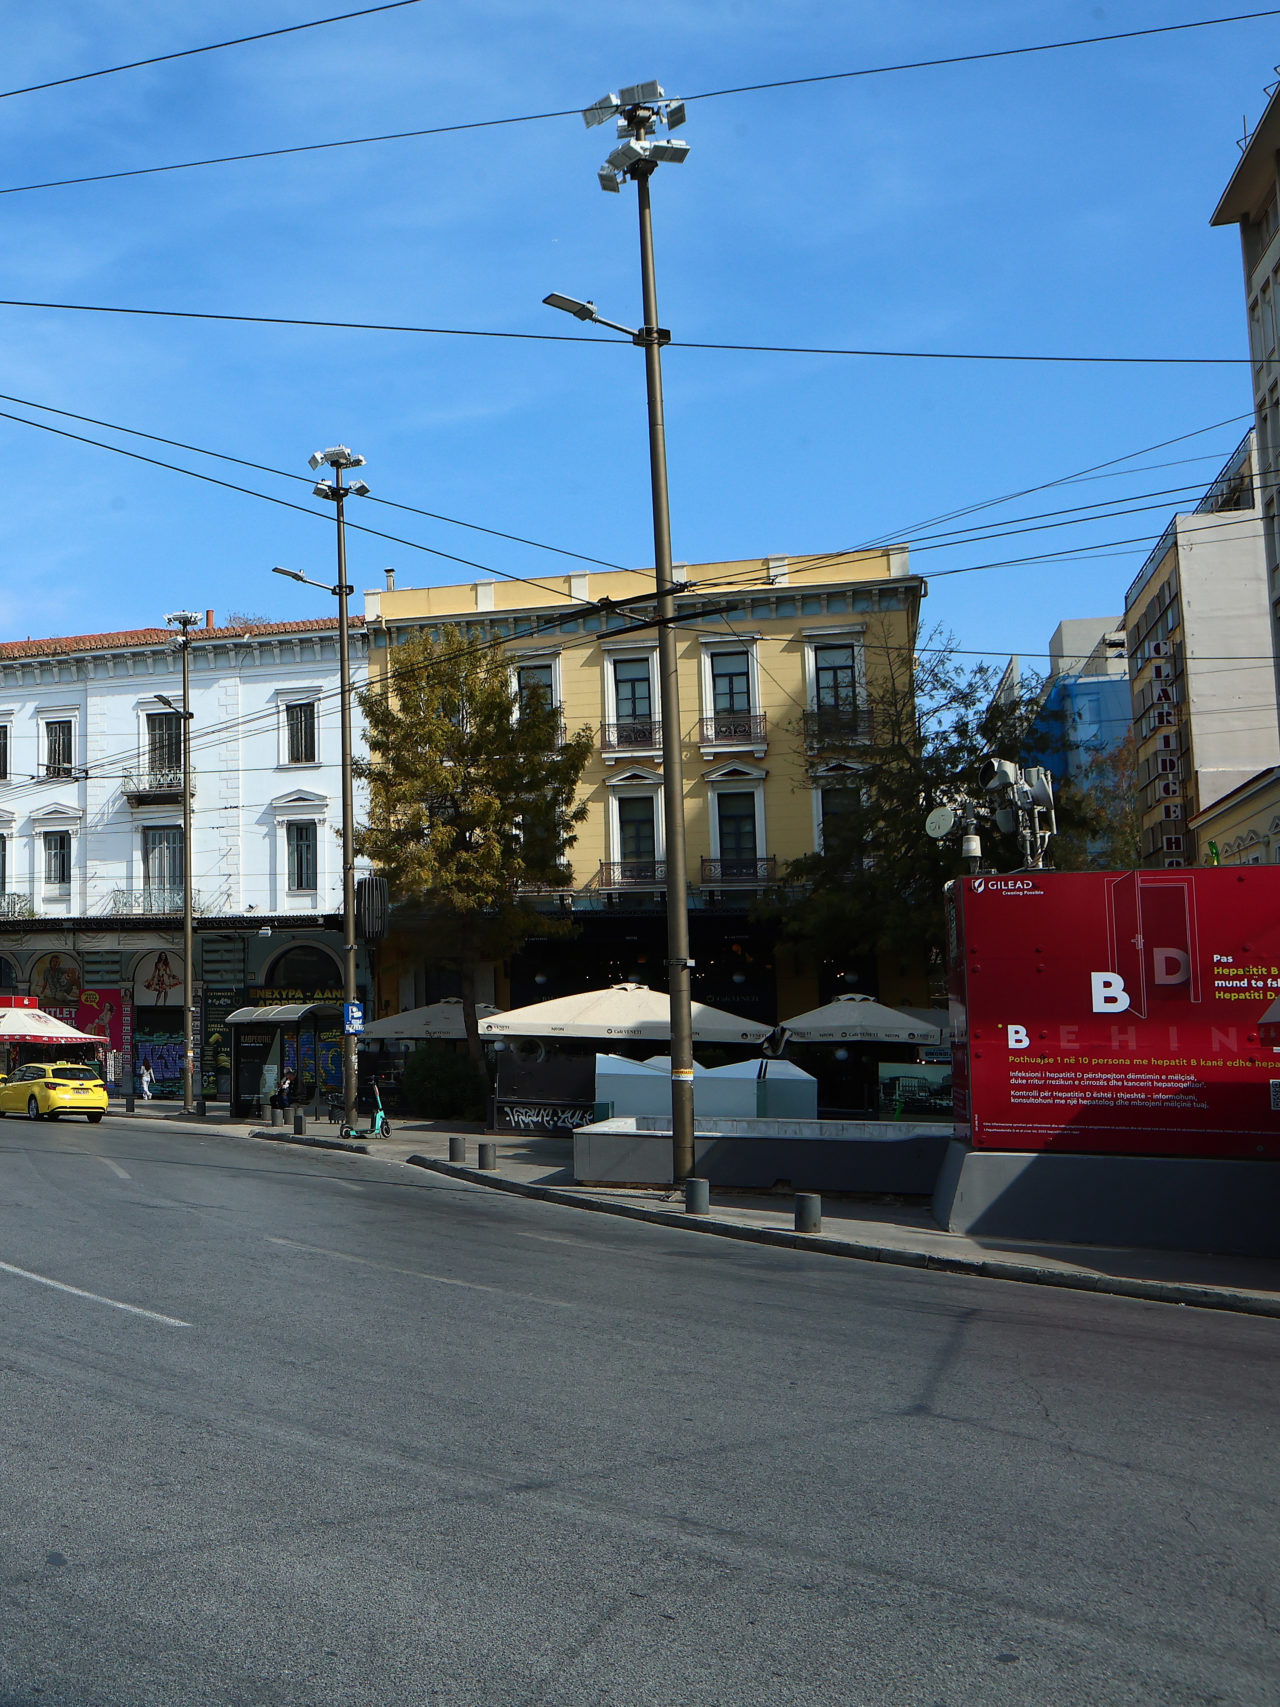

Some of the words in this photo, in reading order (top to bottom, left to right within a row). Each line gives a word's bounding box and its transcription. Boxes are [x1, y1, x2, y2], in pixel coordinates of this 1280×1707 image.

[1152, 640, 1181, 820] CLARIDGE
[988, 880, 1033, 890] GILEAD
[1213, 954, 1233, 963] Pas
[1152, 947, 1191, 985] D
[1214, 965, 1268, 976] Hepatitit
[1271, 966, 1279, 975] B
[1214, 978, 1248, 987] mund
[249, 988, 303, 999] ΕΝΕΧΥΡΑ
[1090, 971, 1131, 1013] B
[1215, 990, 1263, 1000] Hepatiti
[1008, 1055, 1055, 1065] Pothuajse
[1064, 1055, 1076, 1064] në
[1078, 1056, 1089, 1064] 10
[1092, 1057, 1131, 1065] persona
[1151, 1057, 1188, 1067] hepatit
[1190, 1058, 1197, 1066] B
[1200, 1058, 1224, 1067] kanë
[1226, 1059, 1252, 1067] edhe
[1083, 1072, 1125, 1080] përshpejton
[1124, 1080, 1152, 1088] kancerit
[1010, 1089, 1039, 1097] Kontrolli
[1039, 1090, 1052, 1098] për
[1053, 1090, 1085, 1098] Hepatitin
[1117, 1091, 1146, 1100] thjeshtë
[1066, 1098, 1078, 1106] një
[1078, 1098, 1114, 1107] hepatolog
[1130, 1100, 1162, 1108] mbrojeni
